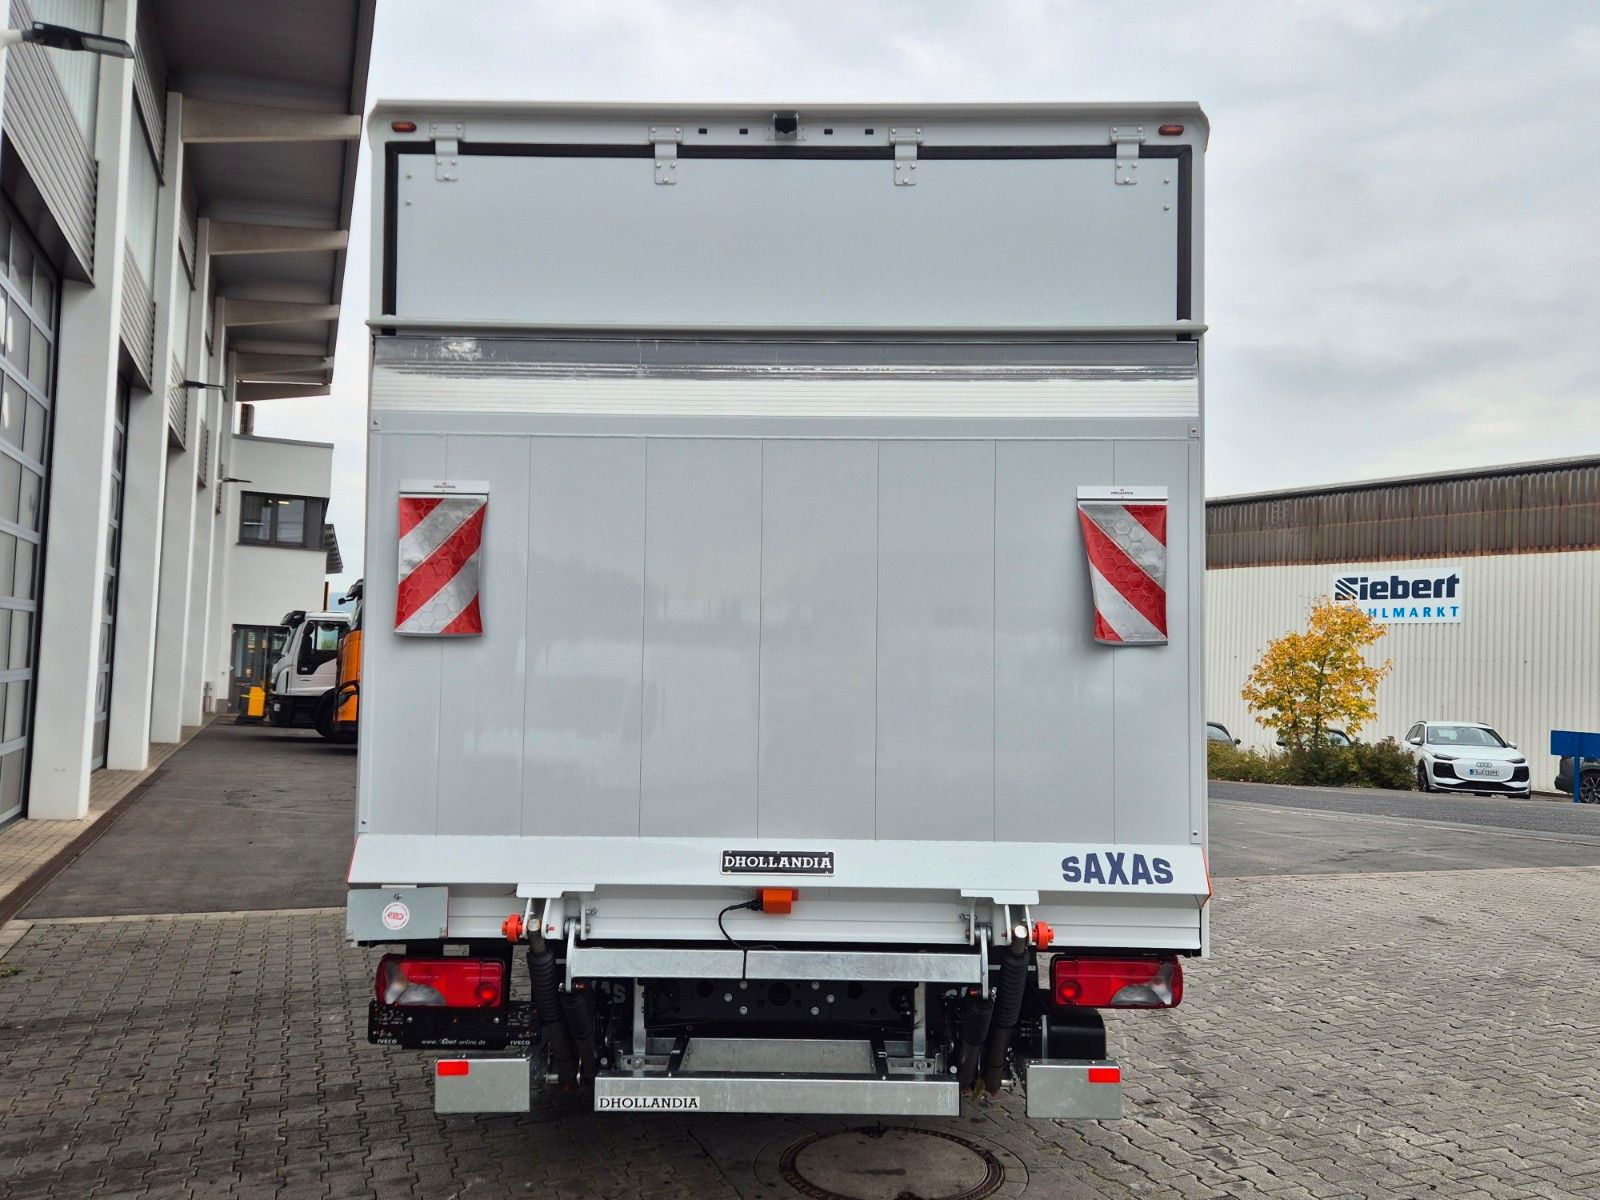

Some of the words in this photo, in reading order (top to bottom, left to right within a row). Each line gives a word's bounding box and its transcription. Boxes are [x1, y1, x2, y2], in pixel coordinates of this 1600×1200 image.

[1334, 573, 1460, 600] Siebert
[1346, 606, 1459, 618] HLMARKT
[724, 855, 832, 869] DHOLLANDIA
[1061, 852, 1174, 885] SAXAS
[599, 1097, 699, 1109] DHOLLANDIA
